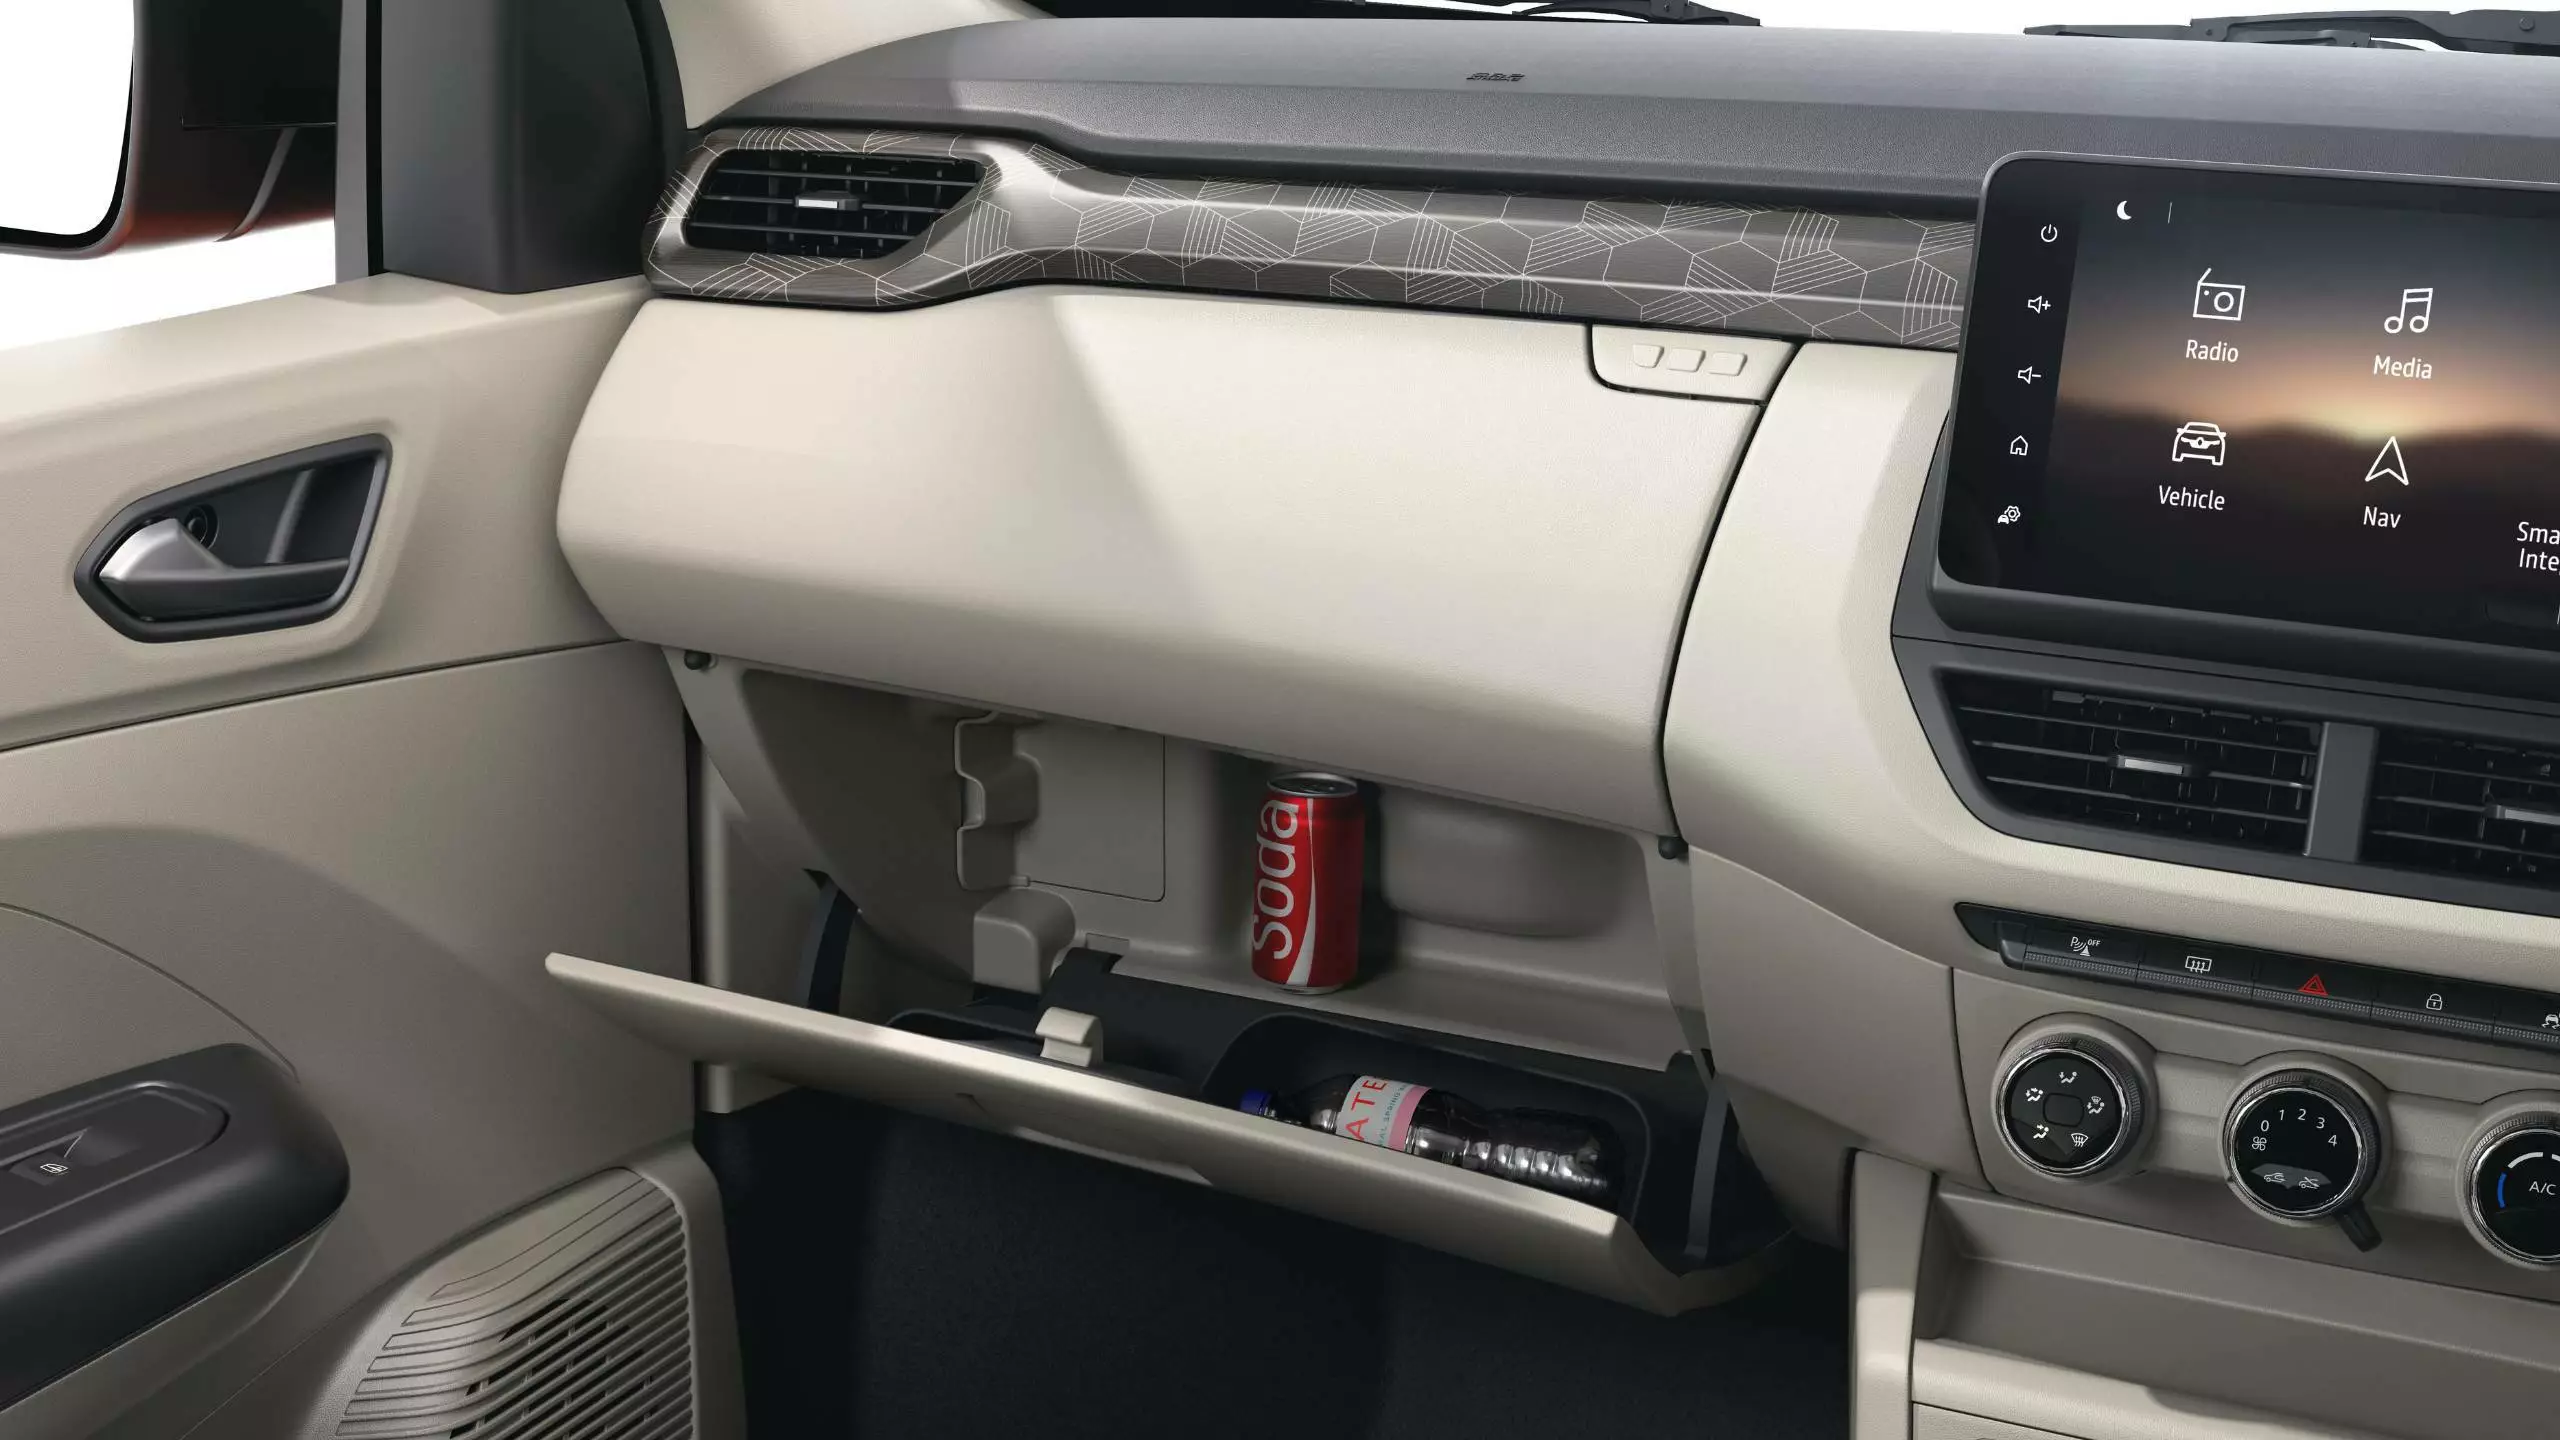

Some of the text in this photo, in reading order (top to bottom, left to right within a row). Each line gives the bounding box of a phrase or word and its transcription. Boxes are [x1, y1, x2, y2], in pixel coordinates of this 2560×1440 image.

[2185, 339, 2239, 363] Radio
[2373, 355, 2433, 380] Media
[2158, 484, 2225, 511] Vehicle
[2363, 505, 2402, 529] Nav
[2516, 521, 2560, 545] Sma
[2519, 547, 2560, 575] Inte
[2087, 939, 2101, 947] OFF
[2260, 1108, 2338, 1147] 0 1 2 3 4
[2528, 1180, 2557, 1196] A/C
